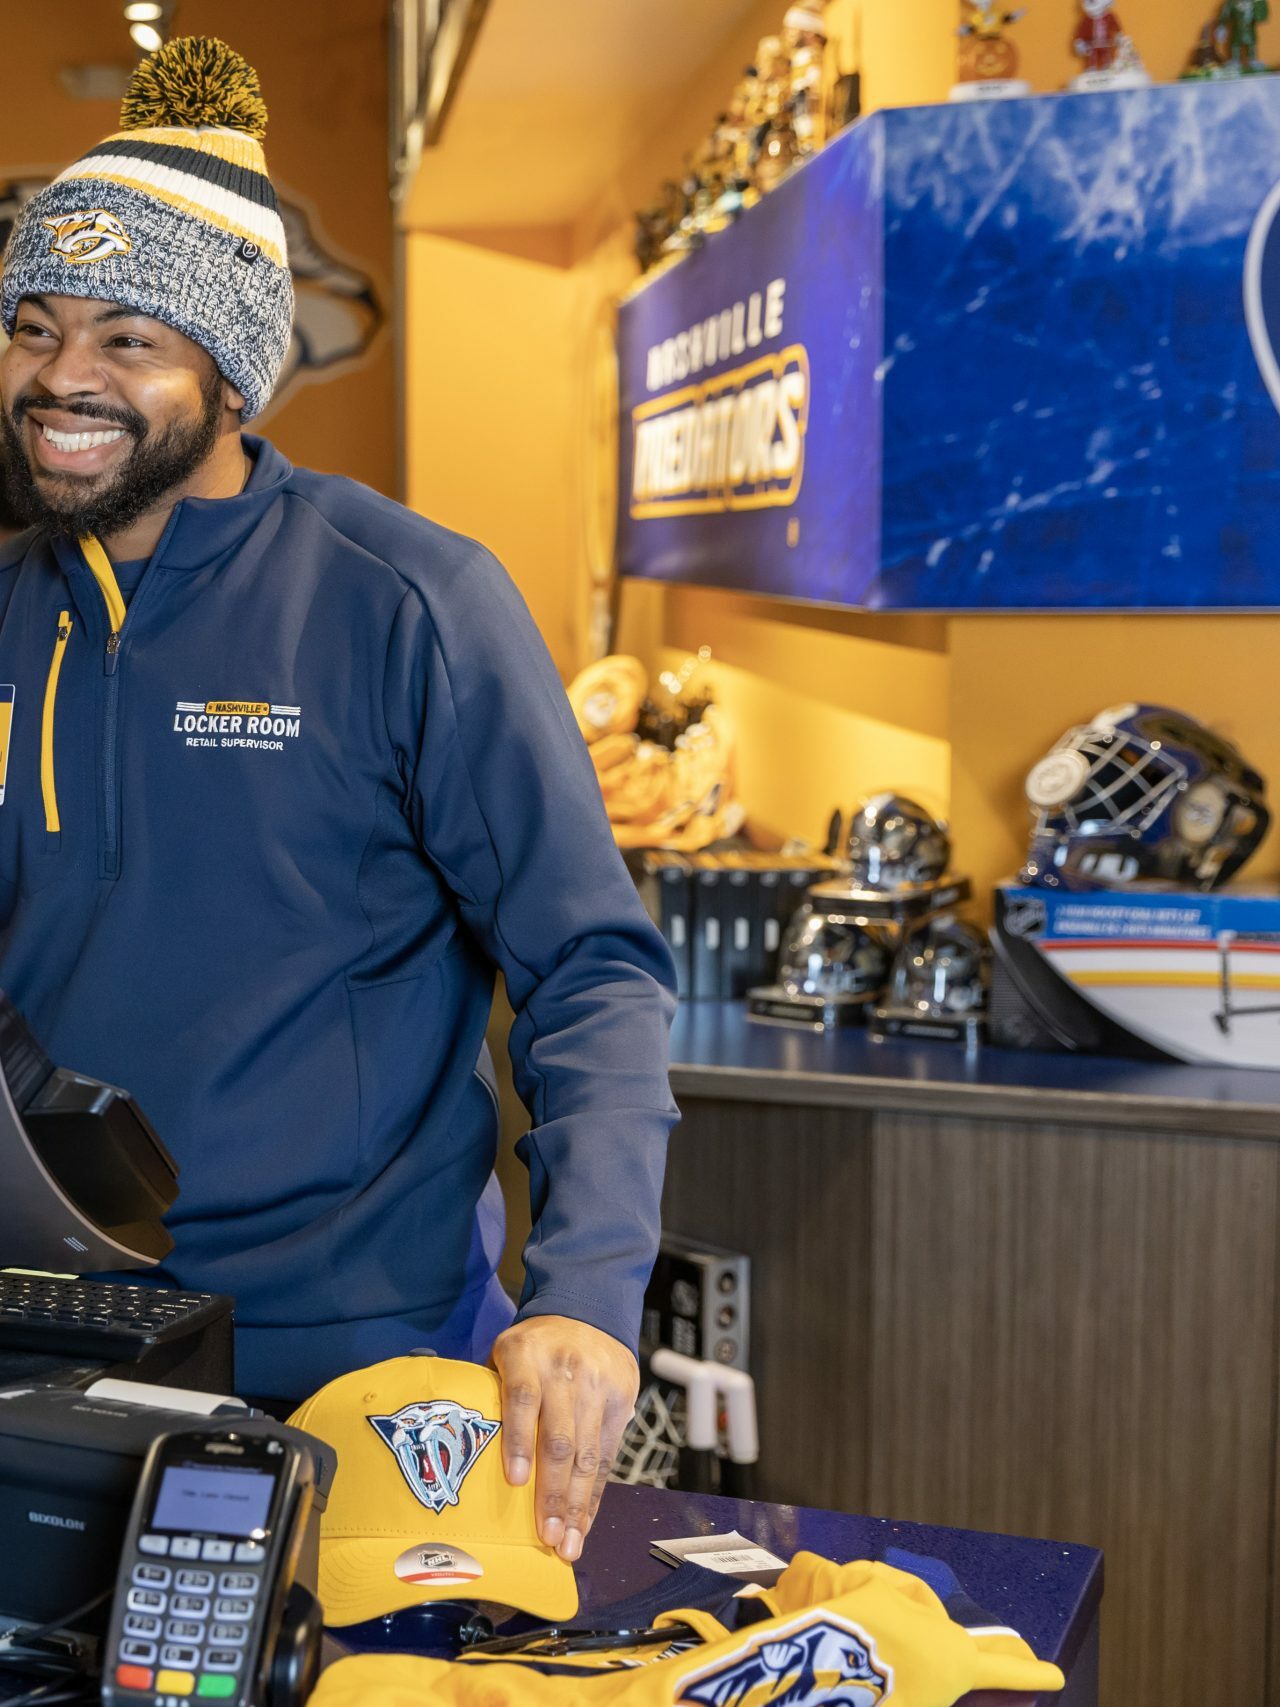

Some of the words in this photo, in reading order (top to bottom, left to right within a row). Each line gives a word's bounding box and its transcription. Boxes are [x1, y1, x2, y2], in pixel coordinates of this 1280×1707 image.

[215, 702, 262, 714] NASHVILLE
[172, 713, 243, 734] LOCKER
[246, 716, 301, 738] ROOM
[184, 737, 219, 748] RETAIL
[219, 737, 285, 751] SUPERVISOR
[28, 1511, 86, 1531] BIXOLON
[427, 1554, 450, 1567] NHL
